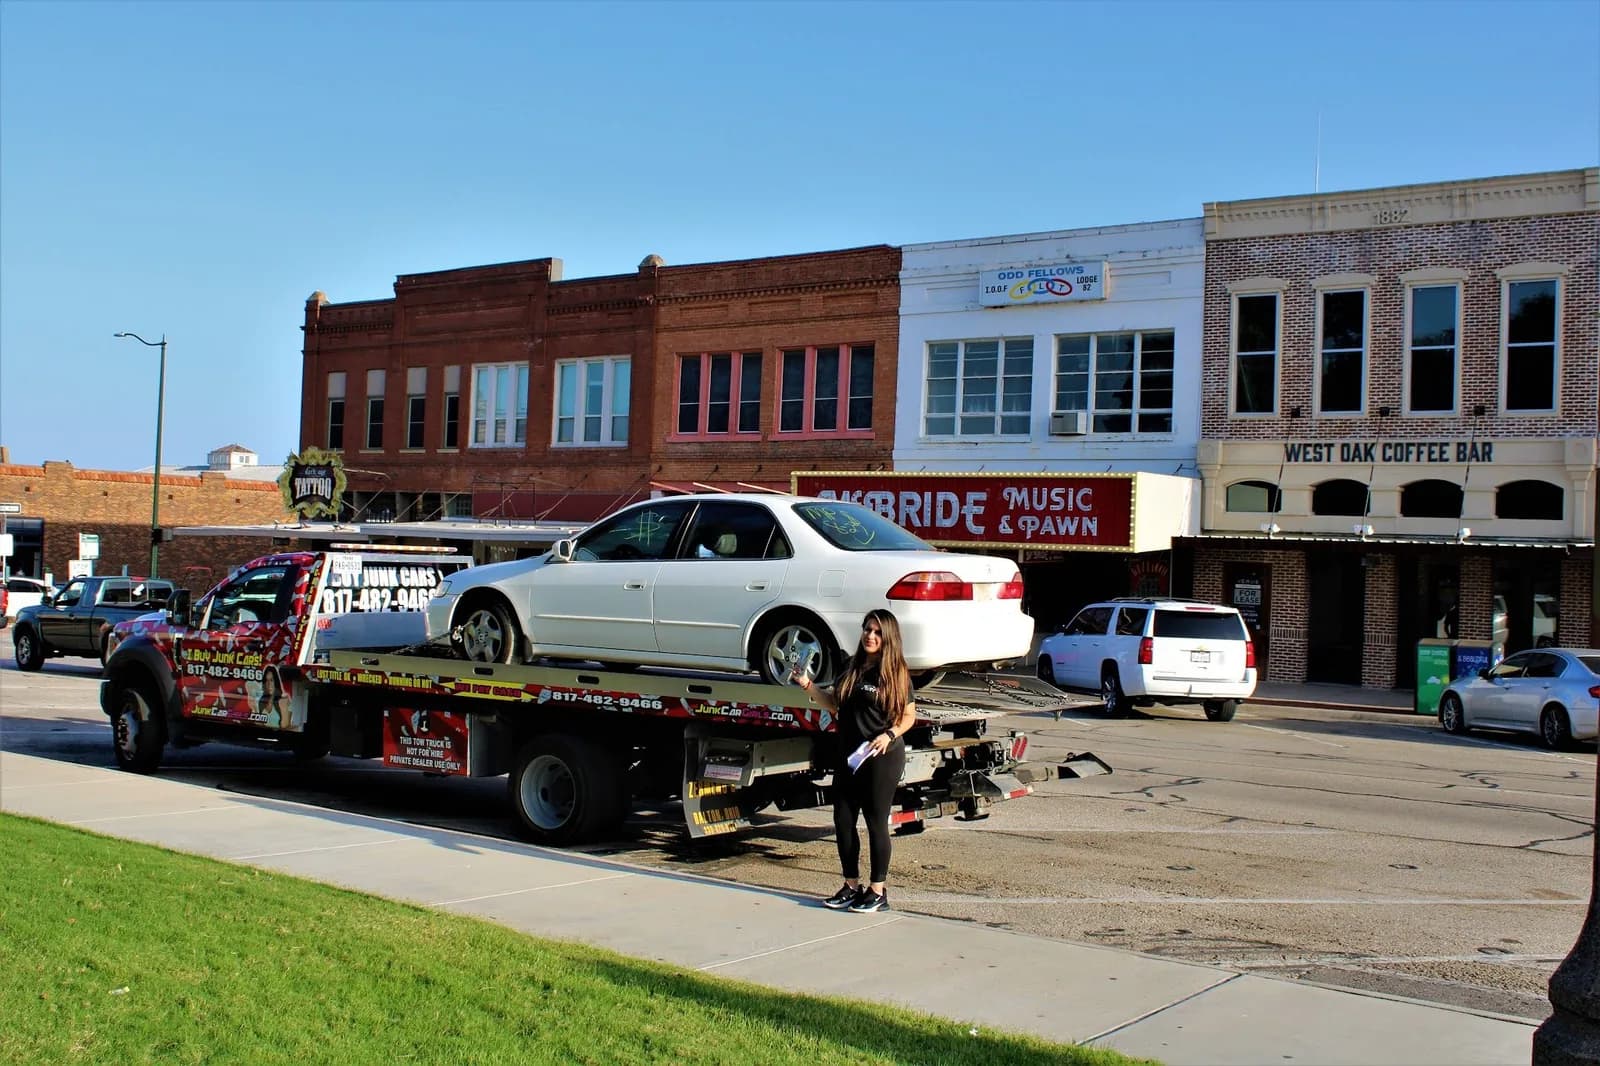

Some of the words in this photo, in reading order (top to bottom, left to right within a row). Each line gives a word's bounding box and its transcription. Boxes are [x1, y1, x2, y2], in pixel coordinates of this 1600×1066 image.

[998, 271, 1023, 281] ODD
[1028, 266, 1085, 278] FELLOWS
[1077, 275, 1098, 284] LODGE
[1039, 282, 1043, 290] L
[1284, 443, 1335, 463] WEST
[1340, 443, 1376, 463] OAK
[1382, 443, 1450, 463] COFFEE
[1456, 442, 1493, 463] BAR
[294, 477, 331, 500] TATTOO
[1002, 487, 1093, 511] MUSIC
[999, 515, 1014, 534] &
[1018, 515, 1098, 540] PAWN
[362, 566, 400, 587] JUNK
[400, 566, 437, 587] CARS
[187, 648, 193, 660] I
[187, 664, 263, 681] 817-482-9466
[421, 679, 432, 689] NOT
[552, 691, 663, 710] 817-482-9466
[400, 736, 412, 745] THIS
[413, 737, 425, 746] TOW
[426, 739, 445, 749] TRUCK
[446, 741, 452, 749] IS
[406, 747, 417, 755] NOT
[419, 748, 430, 757] FOR
[431, 750, 444, 758] HIRE
[389, 755, 411, 765] PRIVATE
[413, 758, 434, 768] DEALER
[434, 760, 445, 769] USE
[447, 762, 460, 771] ONLY
